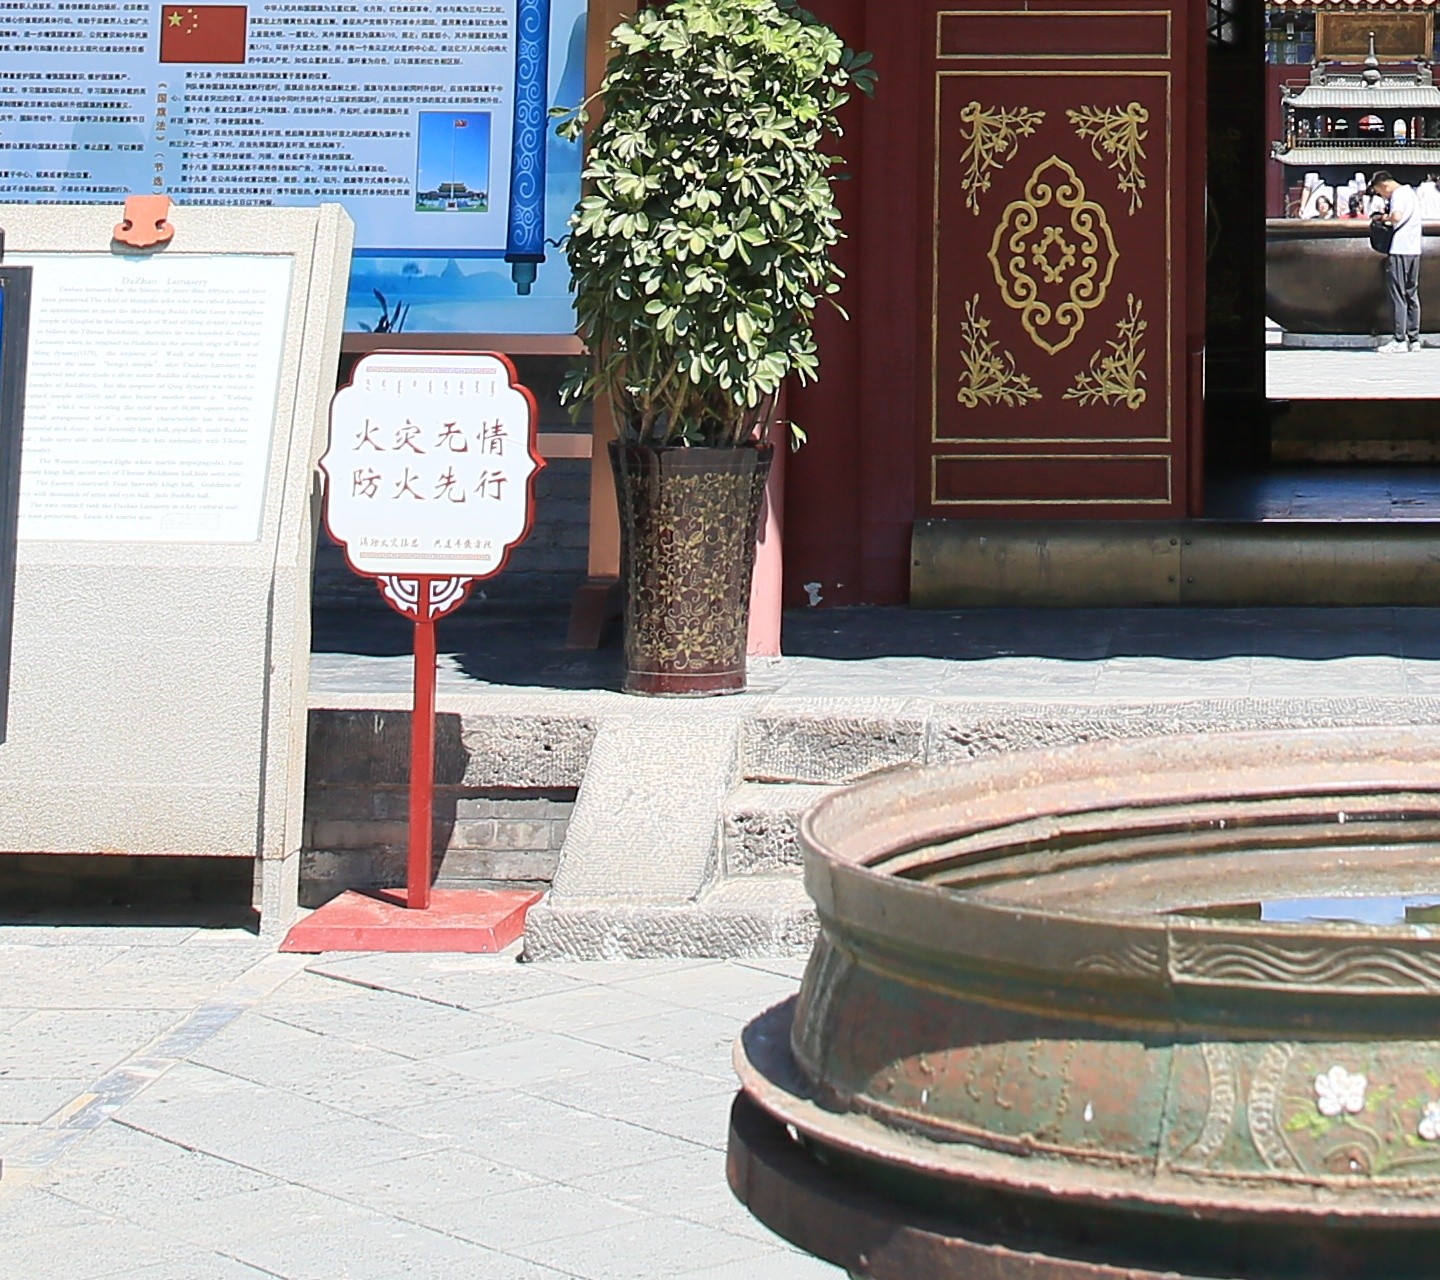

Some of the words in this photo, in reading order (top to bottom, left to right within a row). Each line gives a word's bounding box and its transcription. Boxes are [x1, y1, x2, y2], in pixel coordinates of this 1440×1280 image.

[352, 418, 509, 457] 火灾无情
[351, 466, 509, 504] 防火先行
